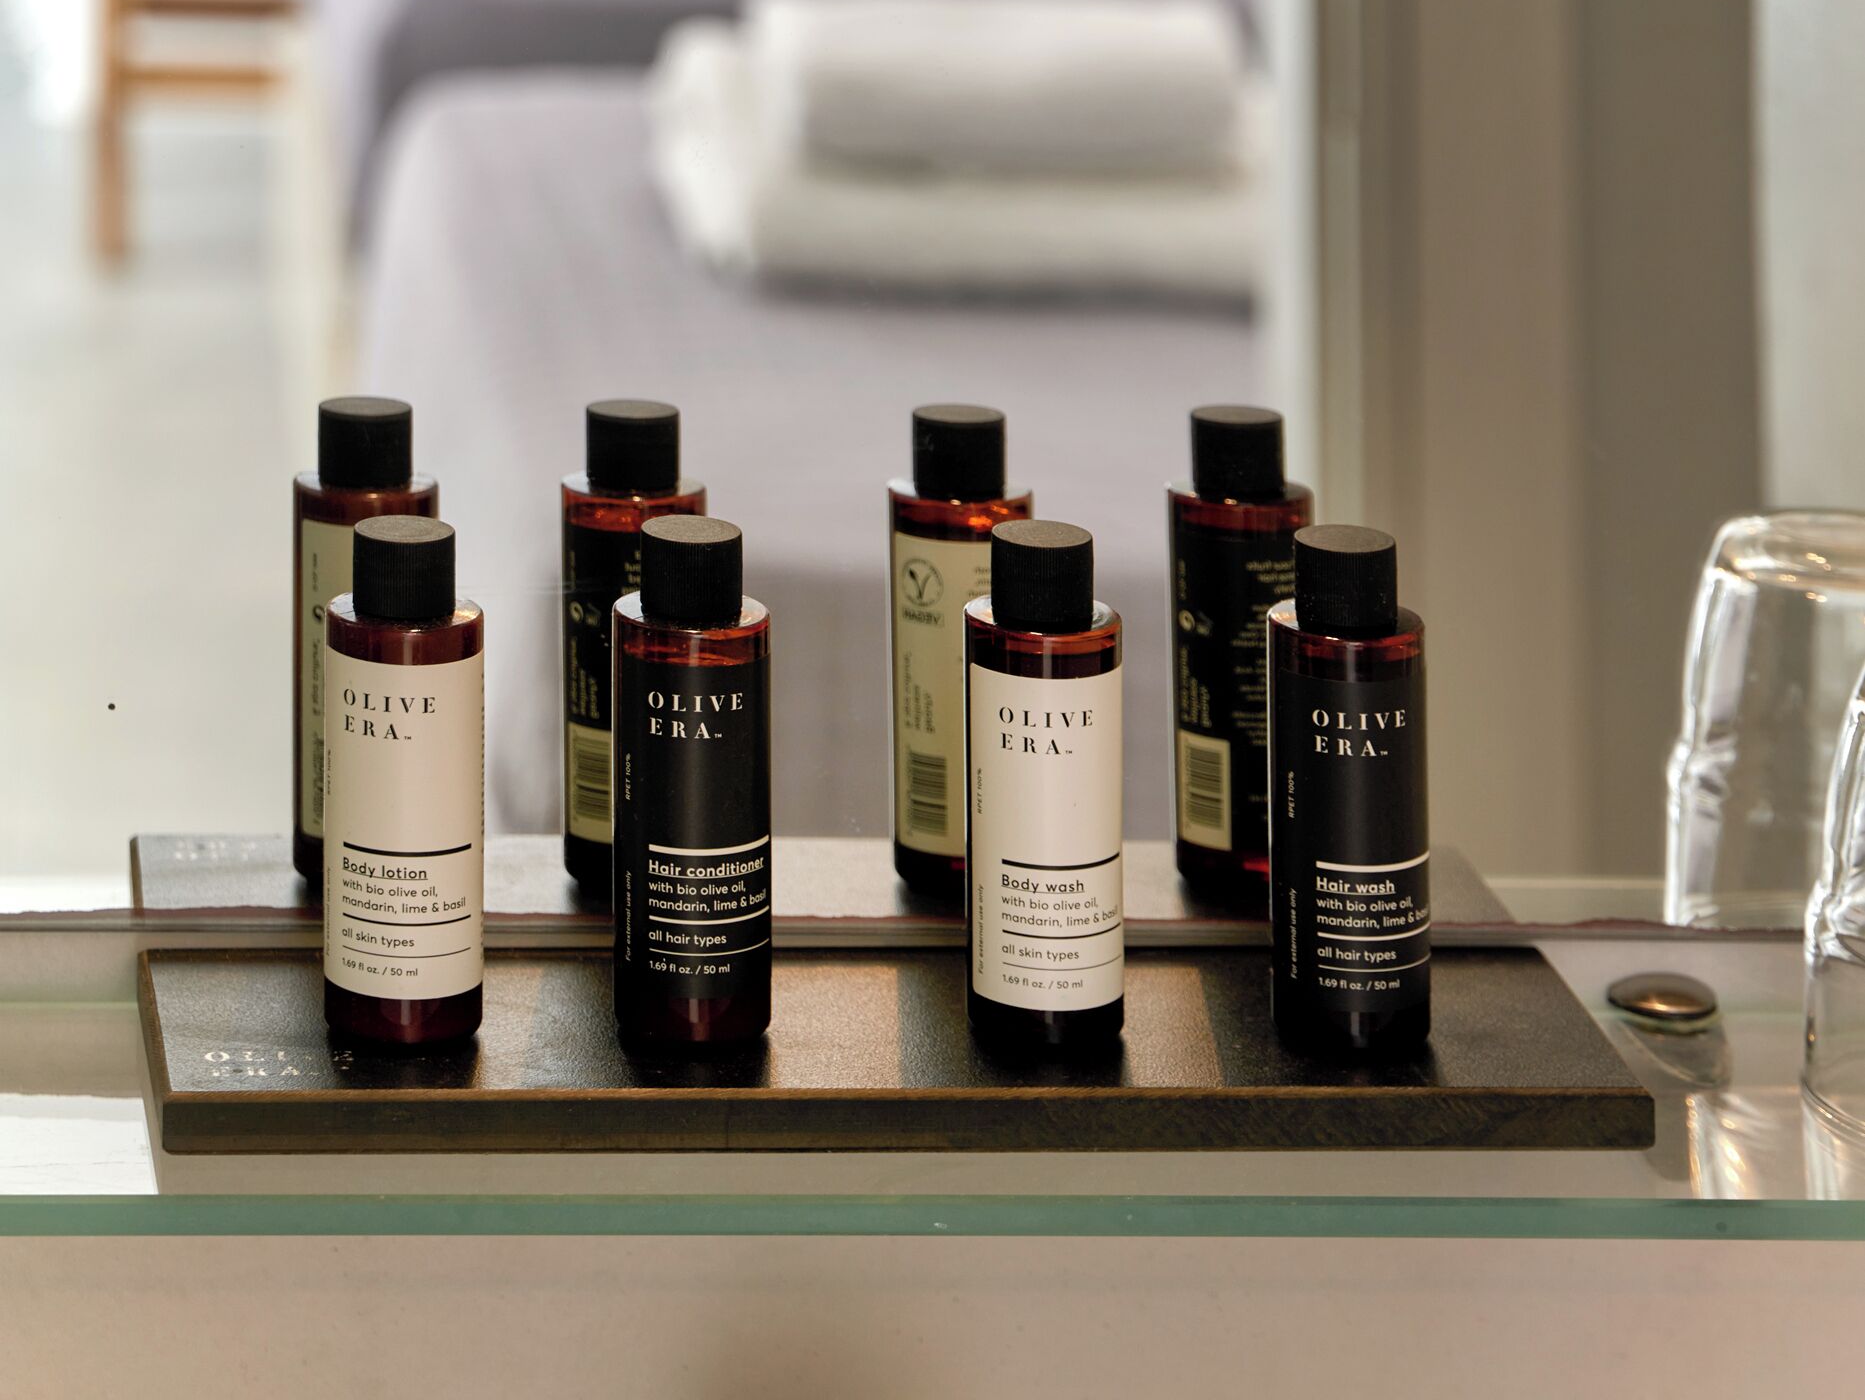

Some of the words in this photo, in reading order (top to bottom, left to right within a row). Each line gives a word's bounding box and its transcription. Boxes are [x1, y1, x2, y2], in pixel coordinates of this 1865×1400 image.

[343, 688, 436, 714] OLIVE
[648, 691, 743, 713] OLIVE
[999, 706, 1093, 728] OLIVE
[1312, 709, 1406, 731] OLIVE
[1287, 770, 1295, 794] 100%
[1287, 795, 1295, 819] RPET
[343, 856, 375, 878] Body
[382, 865, 427, 879] lotion
[648, 859, 681, 876] Hair
[686, 856, 765, 878] conditioner
[342, 878, 363, 892] with
[366, 884, 385, 896] bio
[388, 887, 417, 897] olive
[421, 886, 438, 898] oil,
[648, 881, 673, 894] with
[677, 883, 697, 896] bio
[700, 884, 728, 896] olive
[731, 880, 746, 893] oil,
[1001, 874, 1040, 894] Body
[1046, 879, 1085, 893] wash
[1316, 875, 1351, 893] Hair
[1356, 879, 1395, 895] wash
[342, 895, 398, 914] mandarin,
[401, 903, 427, 914] lime
[431, 902, 439, 913] &
[443, 897, 466, 911] basil
[648, 898, 710, 913] mandarin,
[714, 900, 738, 911] lime
[740, 896, 747, 908] &
[750, 888, 767, 905] basil
[1001, 895, 1026, 908] with
[1029, 899, 1049, 911] bio
[1053, 900, 1081, 911] olive
[1084, 897, 1099, 909] oil,
[1290, 888, 1298, 908] only
[1316, 898, 1343, 911] with
[1346, 900, 1367, 912] bio
[1369, 900, 1397, 912] olive
[1001, 912, 1063, 928] mandarin,
[1066, 915, 1090, 927] lime
[1093, 913, 1100, 923] &
[1317, 914, 1380, 929] mandarin,
[1382, 915, 1406, 927] lime
[1408, 912, 1415, 924] &
[342, 928, 353, 938] all
[356, 931, 377, 944] skin
[381, 936, 415, 948] types
[648, 930, 662, 942] all
[666, 932, 691, 945] hair
[694, 934, 727, 948] types
[1001, 944, 1015, 955] all
[1018, 946, 1042, 959] skin
[1046, 950, 1079, 962] types
[1317, 946, 1333, 958] all
[1336, 947, 1361, 961] hair
[1364, 950, 1397, 963] types
[342, 957, 356, 969] 1.69
[358, 962, 364, 971] fl
[367, 966, 380, 975] oz.
[382, 967, 388, 976] /
[390, 967, 402, 976] 50
[406, 968, 418, 977] ml
[649, 960, 667, 972] 1.69
[669, 963, 676, 973] fl
[679, 966, 693, 975] oz.
[695, 965, 701, 975] /
[703, 965, 716, 975] 50
[718, 963, 730, 973] ml
[1290, 964, 1298, 979] For
[1002, 974, 1020, 985] 1.69
[1022, 977, 1029, 986] fl
[1031, 980, 1046, 989] oz.
[1048, 980, 1054, 989] /
[1056, 980, 1069, 989] 50
[1071, 979, 1083, 989] ml
[1318, 977, 1337, 988] 1.69
[1339, 980, 1347, 989] fl
[1351, 983, 1364, 991] oz.
[1366, 981, 1372, 991] /
[1374, 981, 1386, 990] 50
[1388, 979, 1400, 989] ml
